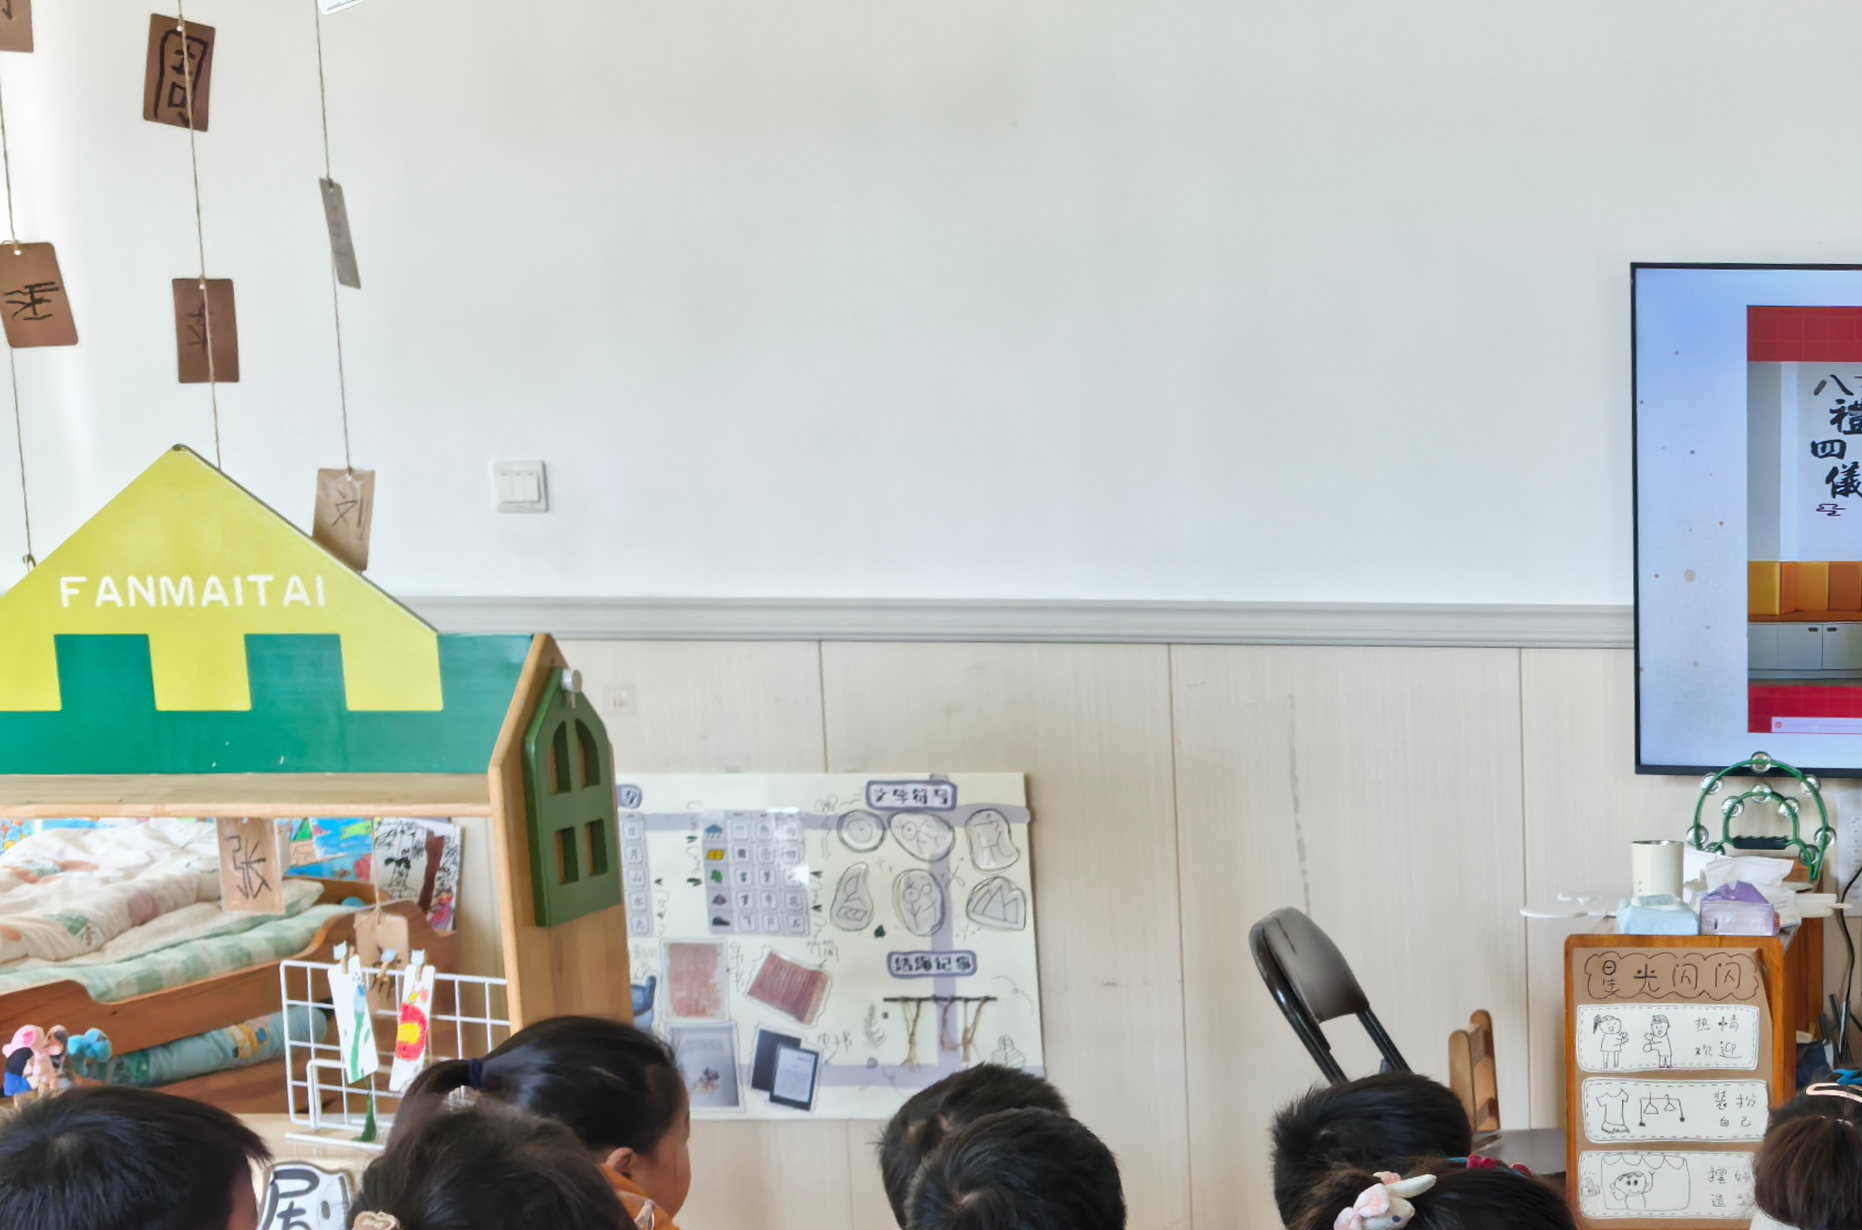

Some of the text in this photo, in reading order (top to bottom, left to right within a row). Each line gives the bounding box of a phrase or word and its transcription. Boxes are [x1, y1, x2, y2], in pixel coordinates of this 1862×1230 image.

[60, 575, 326, 608] FANMAITAI
[1602, 959, 1742, 994] 星光闪闪
